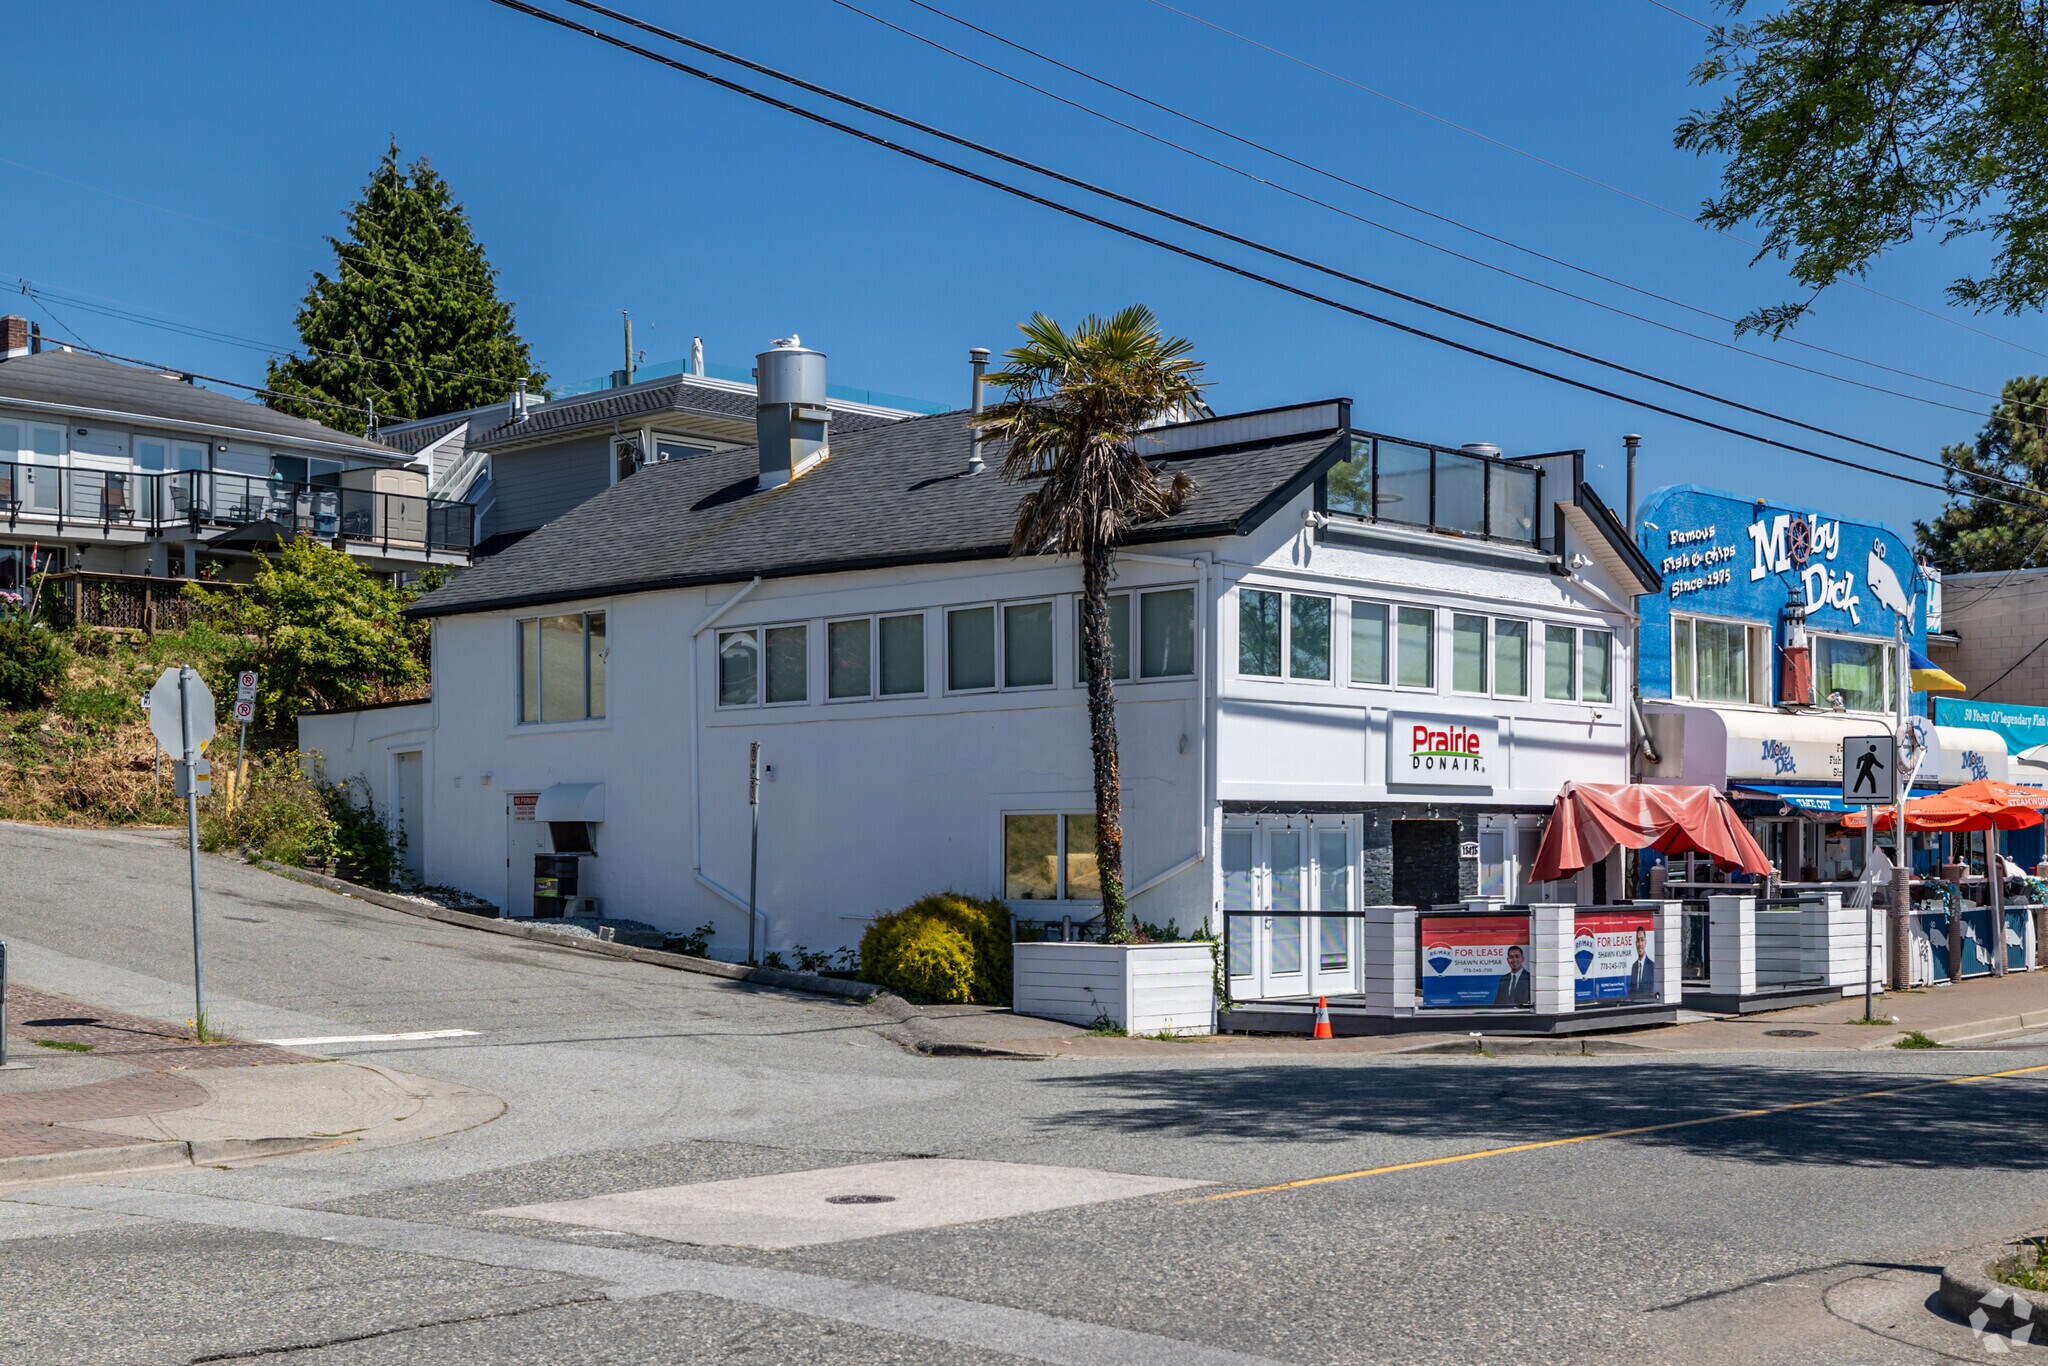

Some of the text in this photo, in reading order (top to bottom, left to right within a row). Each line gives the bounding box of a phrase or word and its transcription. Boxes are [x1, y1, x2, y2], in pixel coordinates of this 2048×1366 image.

[1670, 525, 1716, 545] Famous
[1748, 513, 1840, 581] Moby
[1663, 544, 1736, 574] Fish & Chips
[1671, 568, 1731, 599] Since 1975
[1801, 563, 1861, 625] Dick
[1964, 708, 2046, 728] 50 Years Of Legendary Fish
[1413, 725, 1480, 755] Prairie
[1761, 739, 1791, 760] Moby
[1774, 756, 1797, 775] Dick
[1961, 750, 1984, 769] Moby
[1971, 765, 1989, 781] Dick
[1796, 798, 1831, 810] TAKE OUT
[2007, 797, 2048, 807] STEAMWOR
[1597, 935, 1633, 947] FOR LEASE
[1455, 948, 1504, 957] FOR LEASE
[1598, 950, 1632, 959] SHAWN KUMAR
